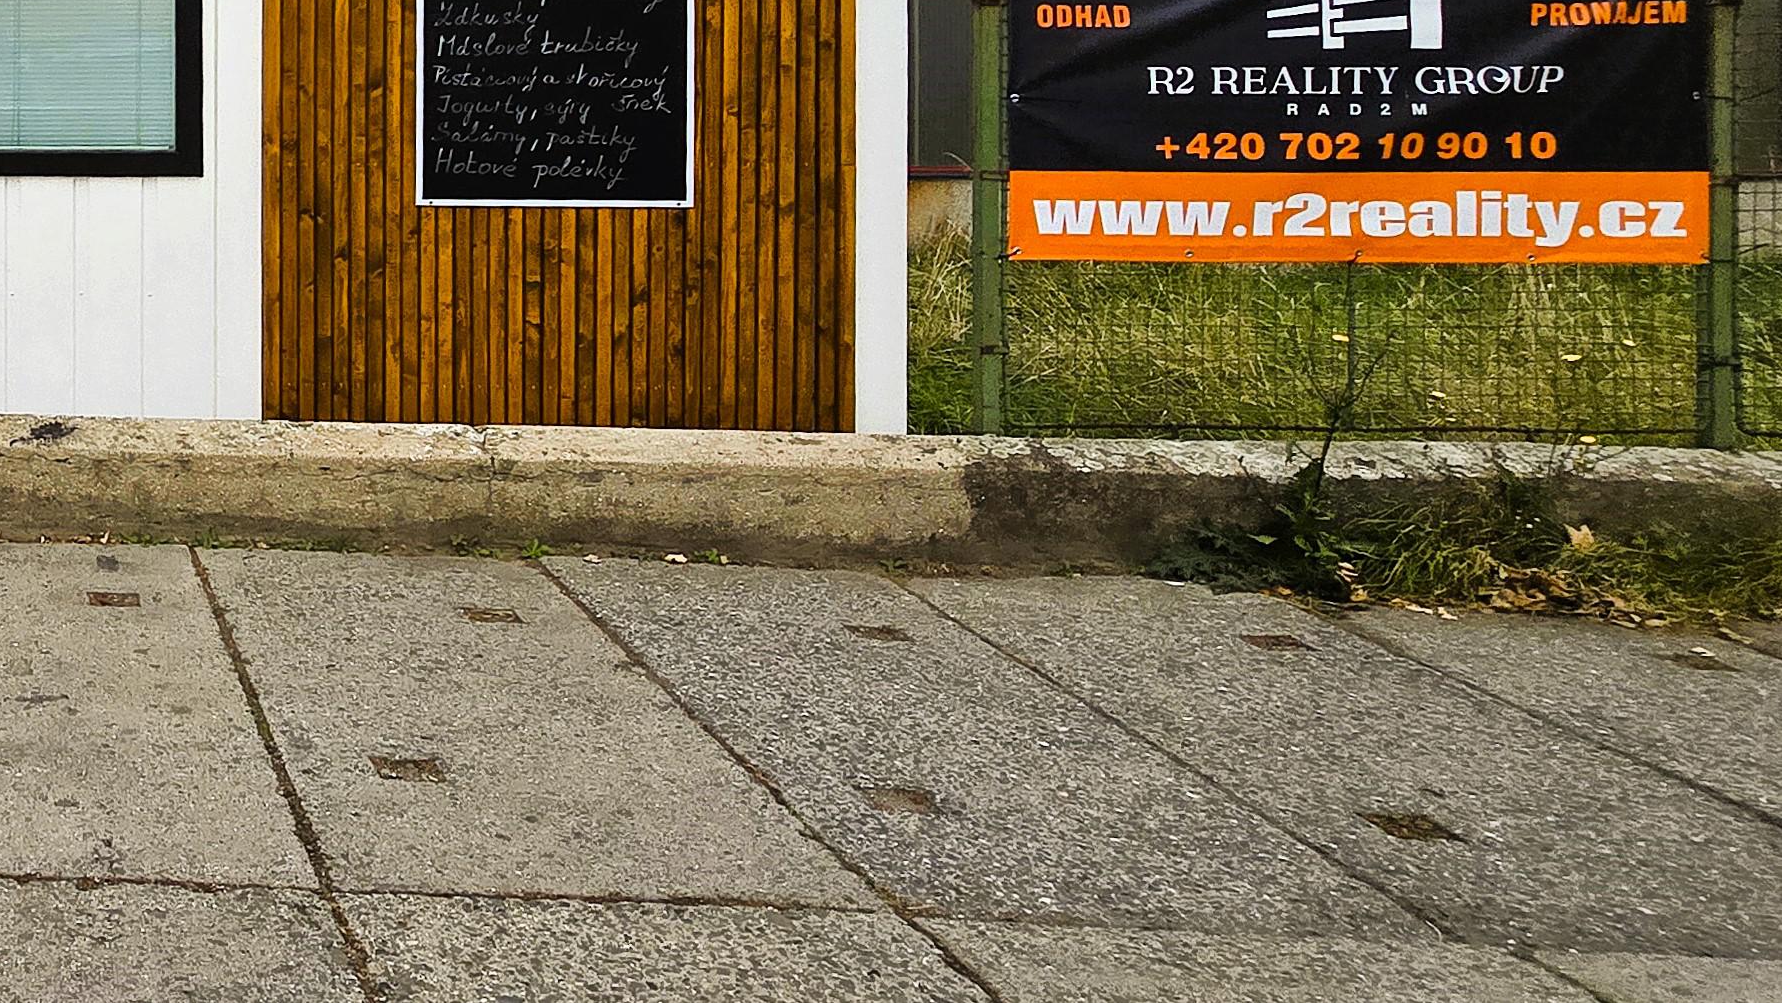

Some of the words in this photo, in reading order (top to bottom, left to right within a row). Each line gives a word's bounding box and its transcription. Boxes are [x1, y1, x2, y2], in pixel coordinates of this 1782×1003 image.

[1037, 4, 1130, 28] ODHAD
[437, 32, 531, 57] Máslové
[541, 26, 638, 69] trubičky
[543, 75, 560, 86] a
[1147, 66, 1194, 95] R2
[1211, 66, 1399, 95] REALITY
[1415, 65, 1564, 94] GROUP
[612, 94, 671, 113] šnek
[1155, 133, 1265, 159] +420
[1280, 133, 1360, 159] 702
[1378, 132, 1424, 159] 10
[1437, 132, 1488, 159] 90
[1505, 132, 1557, 159] 10
[435, 148, 518, 177] Hotové
[532, 156, 626, 190] polévky
[1033, 191, 1687, 246] www.r2reality.cz
